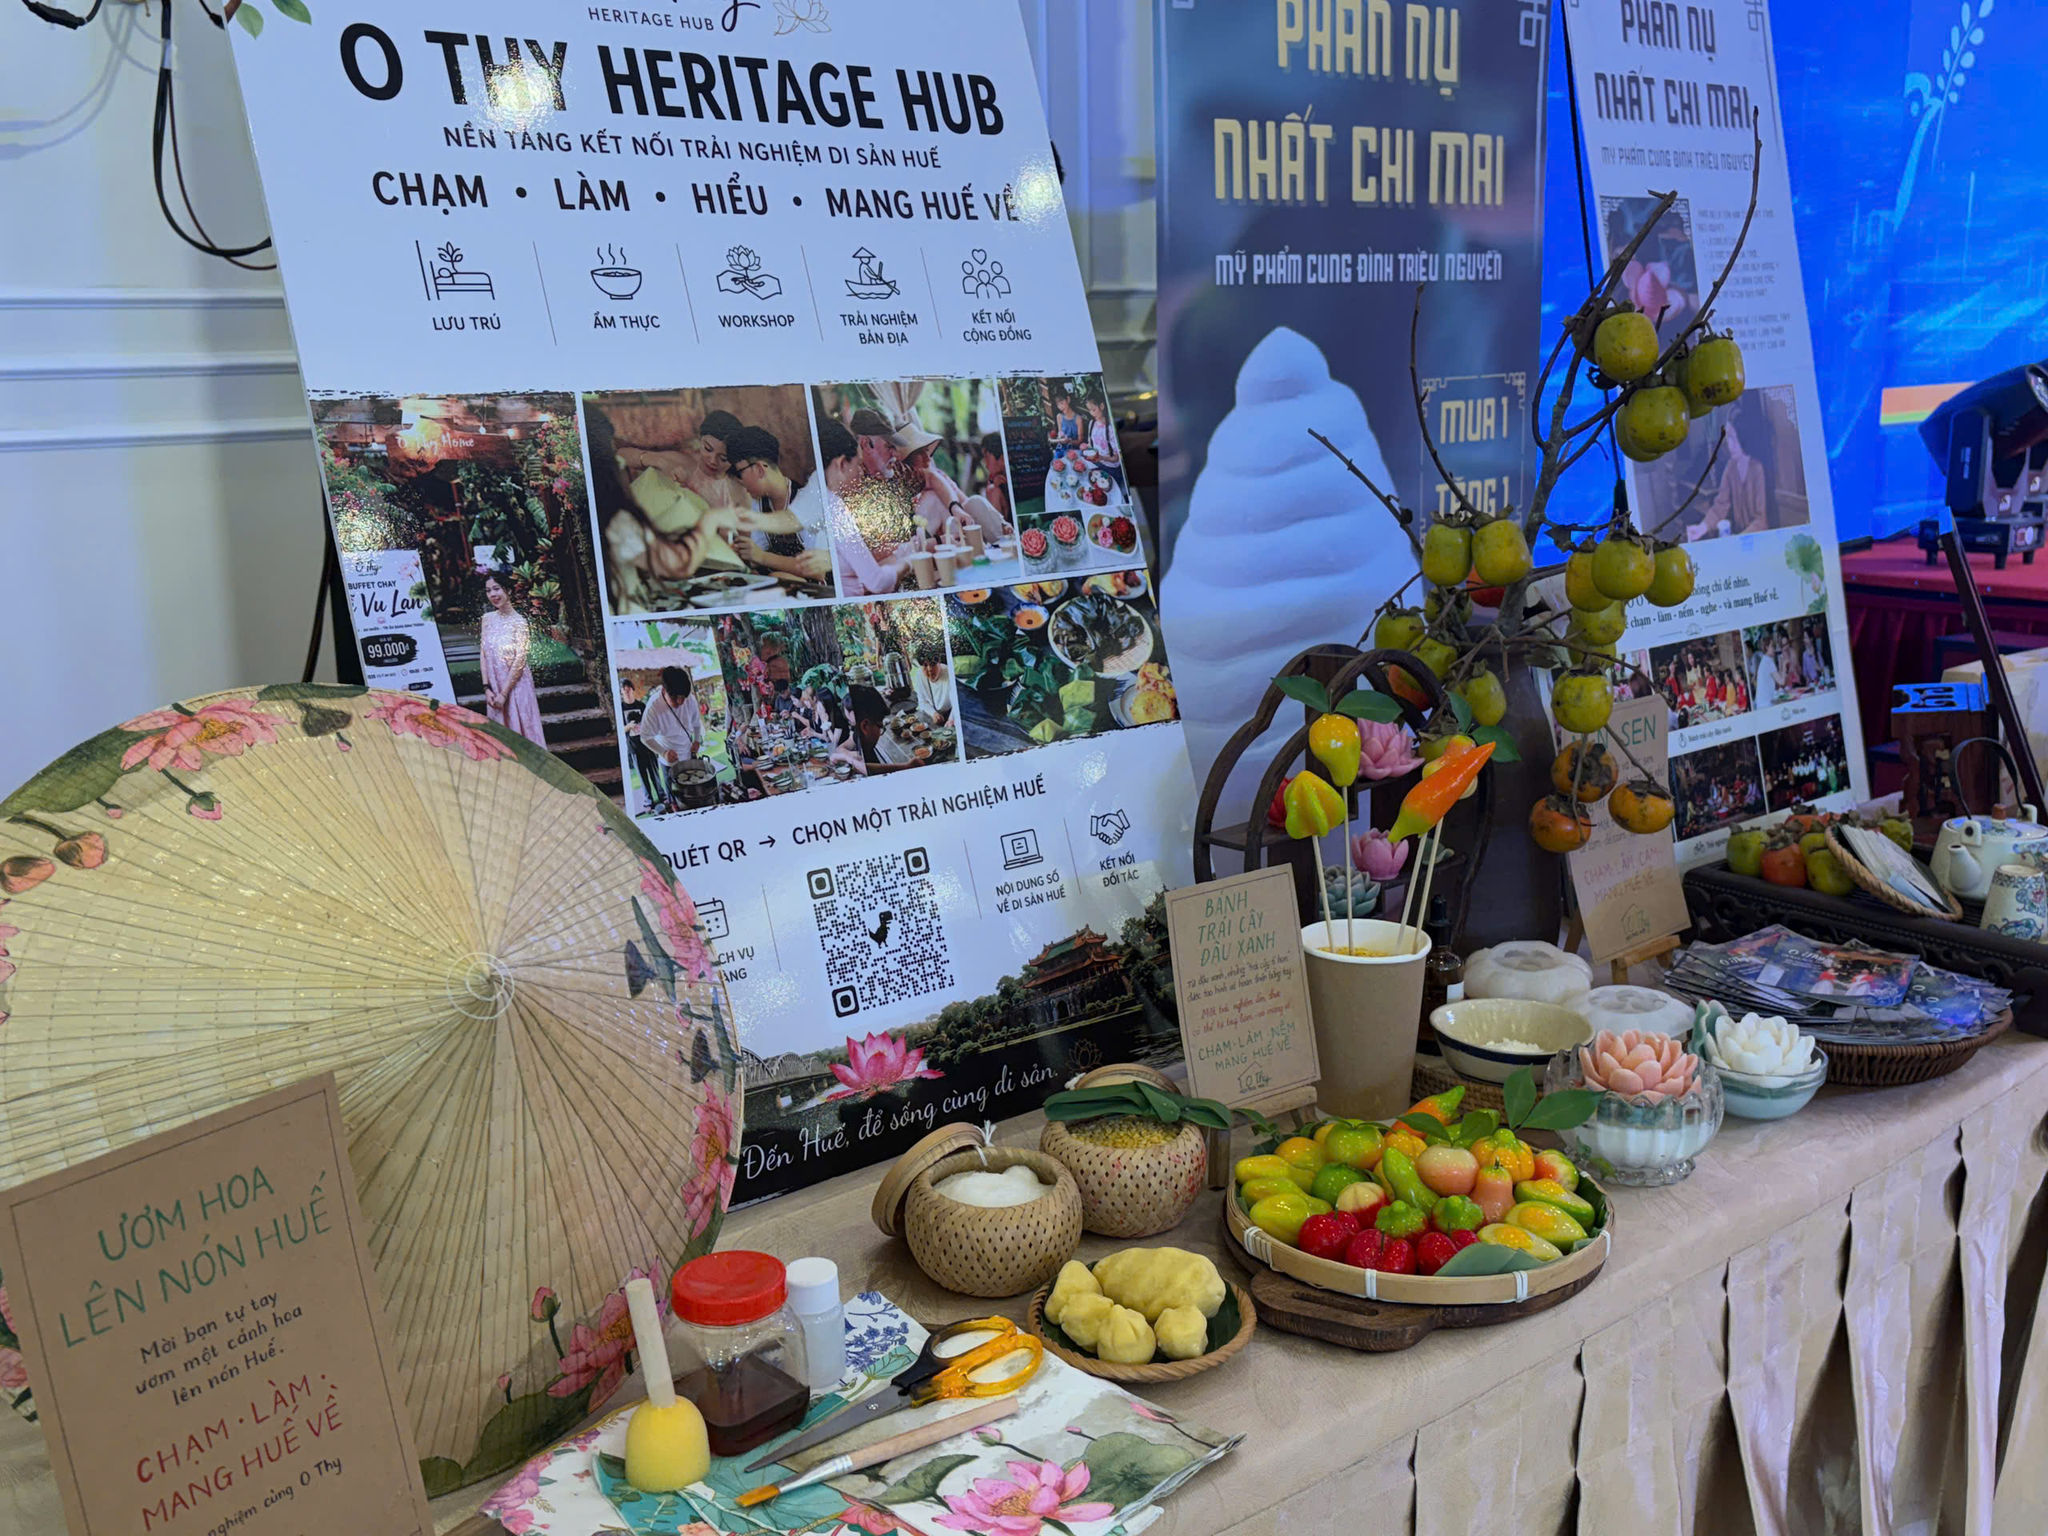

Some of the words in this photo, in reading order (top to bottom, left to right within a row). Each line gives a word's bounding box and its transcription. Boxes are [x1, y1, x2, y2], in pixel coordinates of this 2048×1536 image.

[588, 7, 674, 28] HERITAGE
[679, 16, 715, 31] HUB
[1405, 3, 1459, 96] NỤ
[340, 22, 404, 101] O
[424, 30, 568, 111] THY
[597, 45, 884, 129] HERITAGE
[895, 68, 1004, 135] HUB
[1594, 66, 1656, 122] NHẤT
[1664, 79, 1701, 126] CHI
[1706, 83, 1751, 129] MAI
[443, 121, 497, 149] NỀN
[581, 122, 622, 155] KẾT
[632, 131, 674, 157] NỐI
[681, 135, 730, 160] TRẢI
[738, 140, 822, 166] NGHIỆM
[828, 146, 850, 165] DI
[857, 143, 896, 167] SẢN
[902, 145, 942, 169] HUẾ
[1214, 104, 1335, 203] NHẤT
[1352, 126, 1415, 204] CHI
[1429, 131, 1504, 206] MAI
[372, 171, 489, 215] CHẠM
[554, 170, 631, 211] LÀM
[691, 172, 769, 216] HIỂU
[825, 187, 914, 219] MANG
[920, 182, 979, 221] HUẾ
[1215, 250, 1246, 286] MỸ
[1253, 245, 1302, 285] PHẨM
[1306, 254, 1353, 284] CUNG
[1356, 246, 1394, 283] ĐÌNH
[1397, 248, 1439, 282] TRIỀU
[432, 314, 465, 331] LƯU
[472, 312, 501, 331] TRÚ
[593, 310, 617, 329] ẨM
[622, 314, 660, 332] THỰC
[718, 313, 795, 328] WORKSHOP
[840, 310, 868, 327] TRẢI
[871, 310, 918, 328] NGHIỆM
[963, 328, 996, 344] CỘNG
[999, 325, 1032, 342] ĐỒNG
[971, 310, 992, 325] KẾT
[996, 311, 1016, 325] NỐI
[859, 327, 884, 345] BẢN
[886, 332, 909, 347] ĐỊA
[1440, 398, 1496, 444] MUA
[1501, 397, 1509, 439] 1
[348, 581, 375, 590] BUFFET
[377, 580, 397, 588] CHAY
[361, 592, 387, 617] Vu
[391, 589, 423, 618] Lan
[1630, 614, 1651, 630] chạm
[1657, 610, 1672, 624] làm
[1678, 604, 1694, 620] nếm
[1700, 600, 1718, 615] nghe
[1723, 601, 1732, 610] và
[1733, 595, 1753, 609] mang
[1753, 588, 1768, 604] Huế
[1621, 714, 1657, 747] SEN
[718, 838, 747, 862] QR
[792, 817, 848, 844] CHỌN
[853, 807, 899, 833] MỘT
[898, 796, 938, 824] TRẢI
[942, 785, 1009, 814] NGHIỆM
[1013, 773, 1047, 800] HUẾ
[1099, 855, 1117, 871] KẾT
[1118, 853, 1136, 867] NỐI
[1102, 871, 1121, 888] ĐỐI
[1121, 868, 1140, 883] TÁC
[995, 883, 1015, 897] NỘI
[1016, 877, 1045, 893] DUNG
[1047, 870, 1060, 885] SỐ
[1013, 896, 1023, 909] DI
[1024, 891, 1044, 907] SẢN
[1046, 884, 1067, 903] HUẾ
[1239, 909, 1264, 933] CÂY
[737, 946, 755, 961] VỤ
[1237, 931, 1276, 959] XANH
[1215, 1055, 1248, 1071] MANG
[743, 1143, 793, 1180] Đến
[798, 1122, 851, 1162] Huế,
[858, 1106, 885, 1142] để
[889, 1101, 938, 1131] sống
[942, 1086, 991, 1113] cùng
[994, 1064, 1016, 1096] di
[1020, 1062, 1059, 1088] sản.
[98, 1199, 187, 1261] ƯƠM
[199, 1165, 275, 1220] HOA
[59, 1279, 147, 1348] LÊN
[159, 1234, 246, 1303] NÓN
[255, 1169, 333, 1259] HUẾ
[139, 1335, 178, 1364] Mời
[183, 1318, 218, 1343] bạn
[225, 1305, 246, 1323] tự
[251, 1291, 279, 1314] tay
[135, 1368, 176, 1395] ươm
[183, 1345, 219, 1370] một
[227, 1320, 268, 1351] cánh
[273, 1305, 303, 1330] hoa
[172, 1381, 202, 1406] lên
[208, 1360, 240, 1388] nón
[243, 1336, 284, 1370] Huế.
[136, 1418, 230, 1484] CHẠM
[251, 1379, 312, 1425] LÀM
[141, 1465, 234, 1533] MANG
[241, 1405, 301, 1478] HUẾ
[306, 1383, 343, 1438] VỀ
[263, 1485, 295, 1509] cùng
[300, 1470, 311, 1487] O
[313, 1453, 343, 1484] Thy
